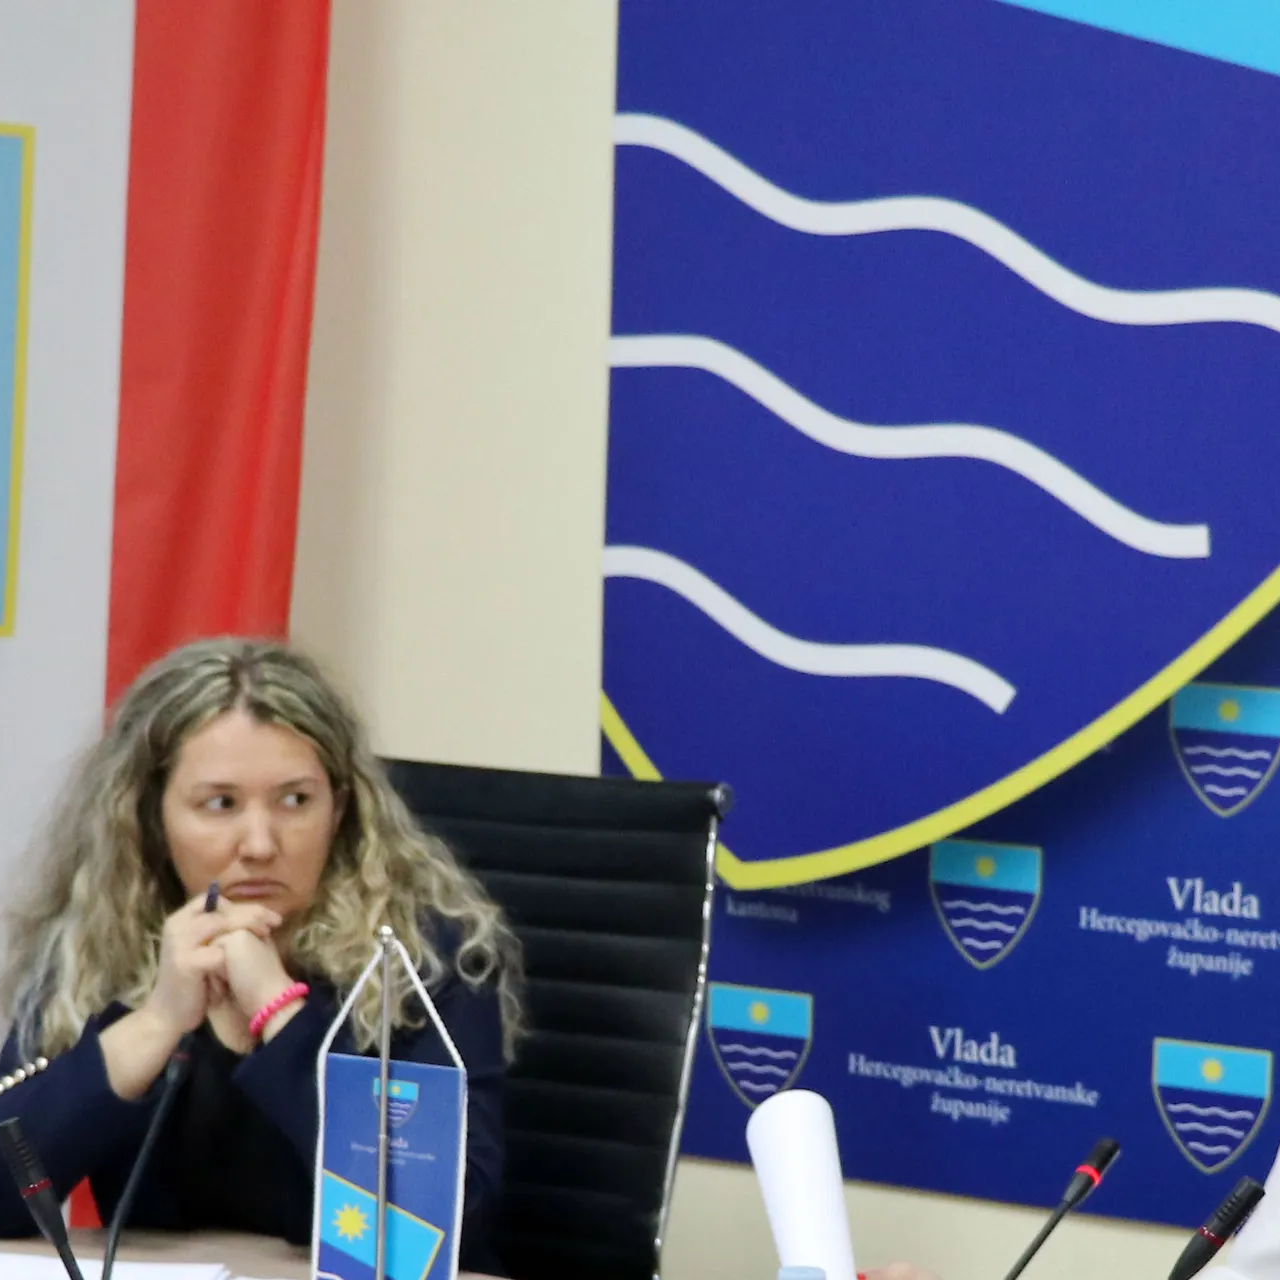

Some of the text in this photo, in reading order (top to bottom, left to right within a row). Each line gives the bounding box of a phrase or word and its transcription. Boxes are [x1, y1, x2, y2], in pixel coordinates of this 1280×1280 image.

[1166, 876, 1261, 920] Vlada
[1166, 945, 1255, 979] županije
[929, 1025, 1016, 1069] Vlada
[847, 1052, 1099, 1108] Hercegovačko-neretvanske
[930, 1091, 1011, 1125] županije
